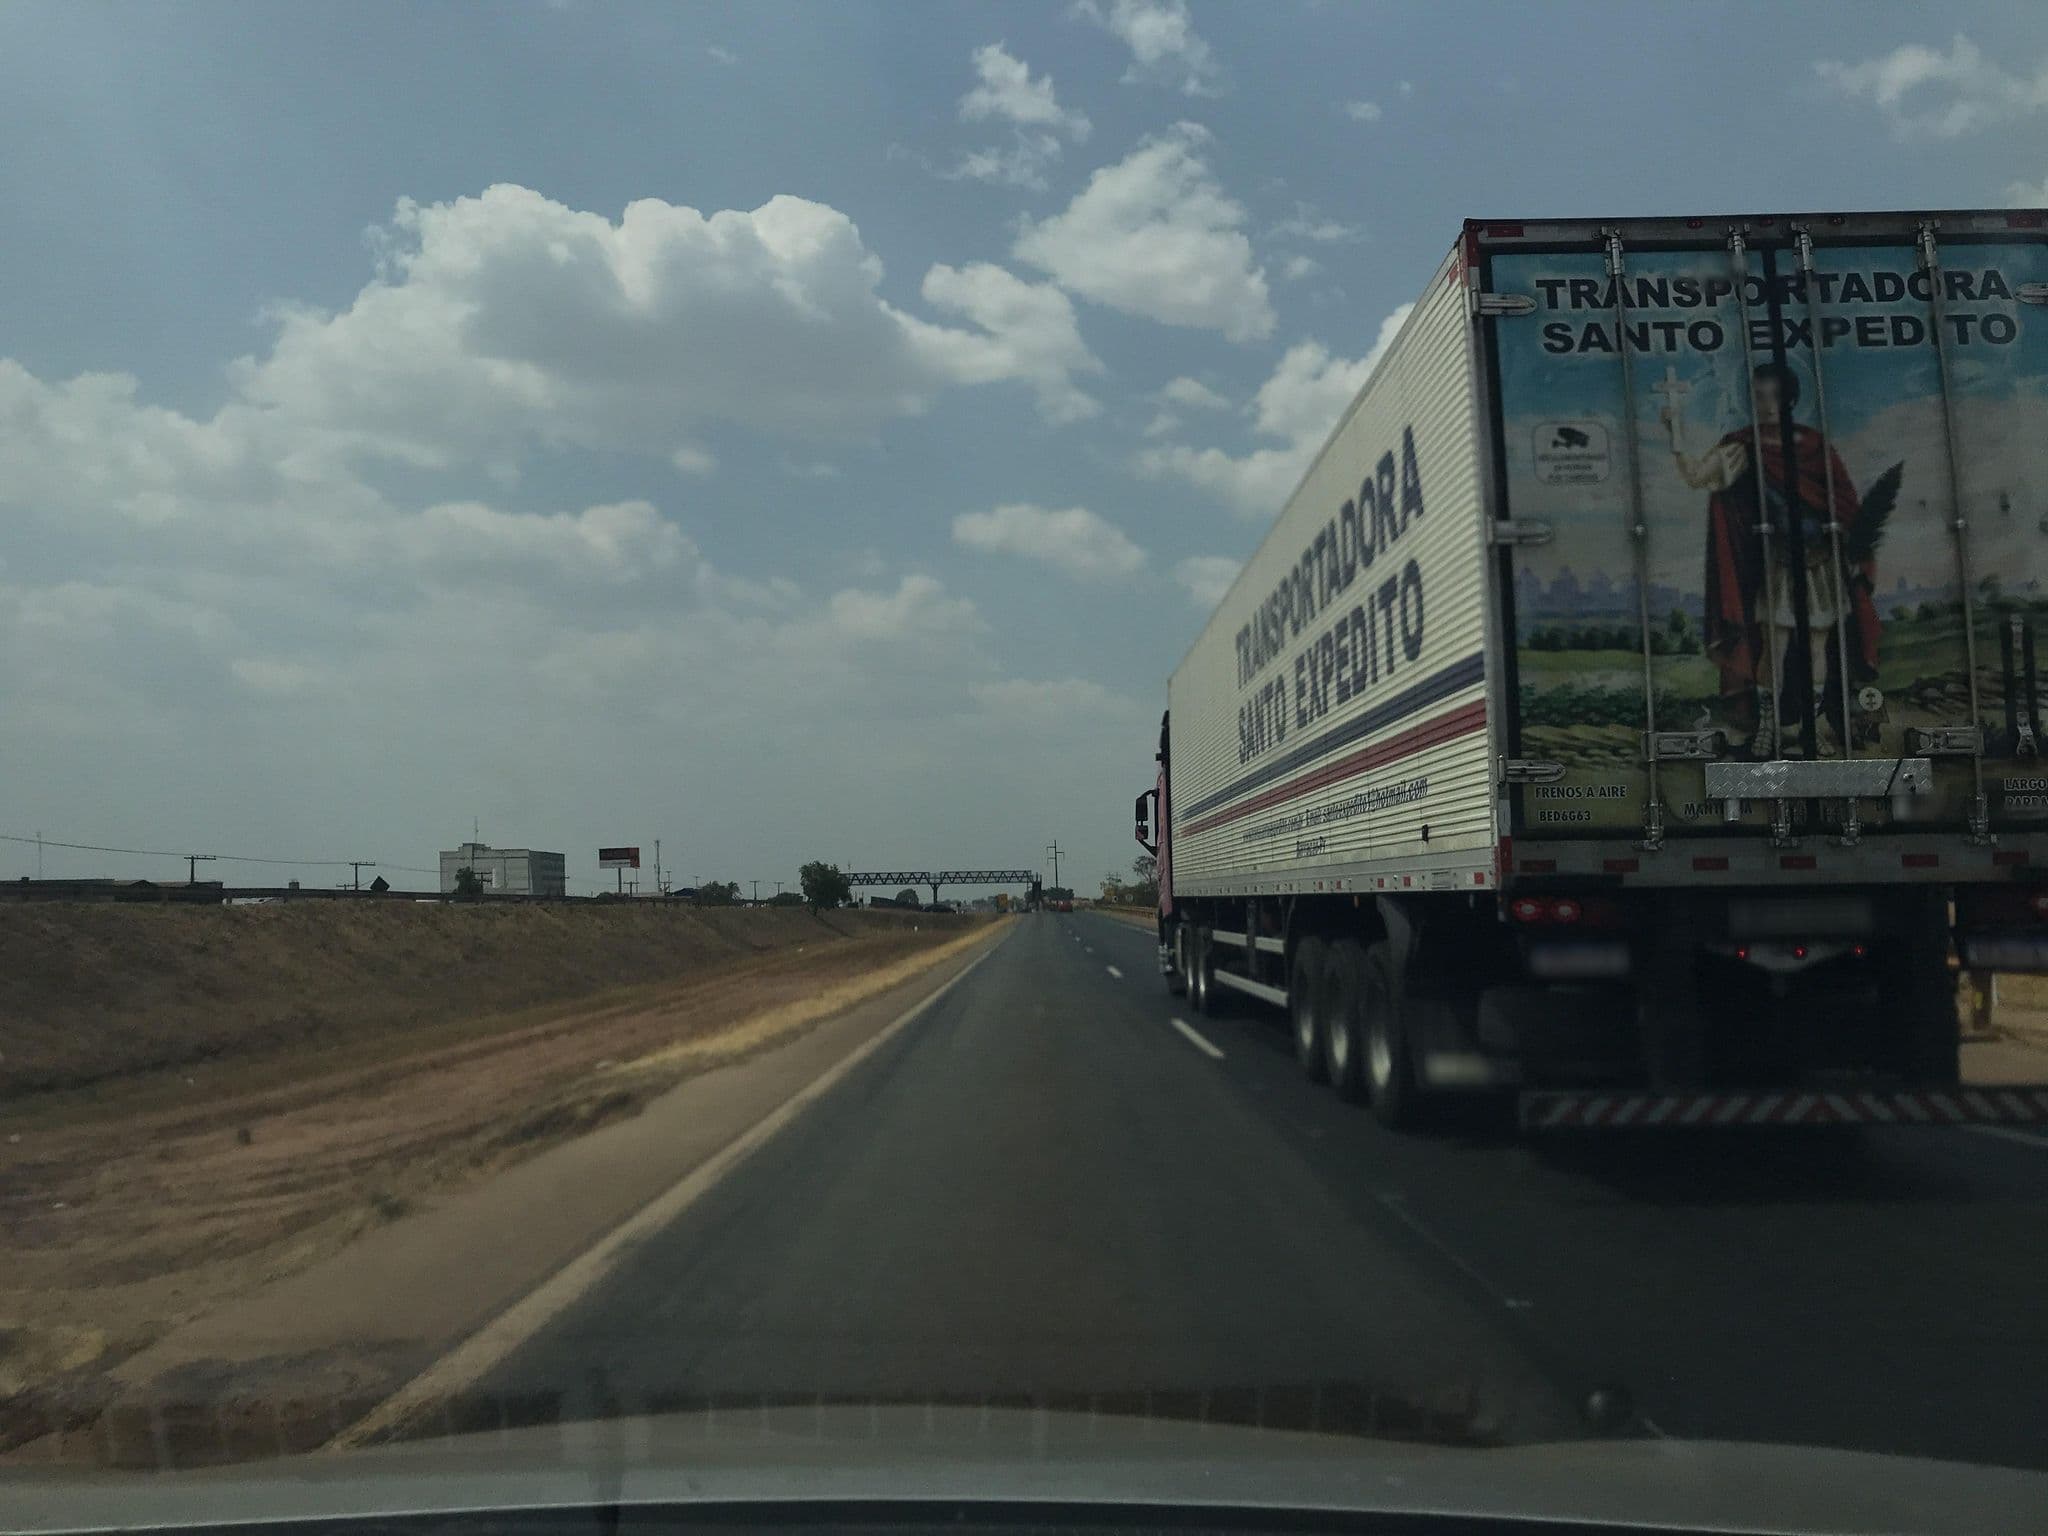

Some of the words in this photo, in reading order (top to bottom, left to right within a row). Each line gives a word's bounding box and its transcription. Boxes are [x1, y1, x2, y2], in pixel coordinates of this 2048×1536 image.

[1536, 270, 2013, 309] TRANSPORTADORA
[1543, 320, 1724, 353] SANTO
[1235, 424, 1424, 690] TRANSPORTADORA
[1238, 676, 1286, 764] SANTO
[1295, 558, 1424, 730] EXPEDITO
[1535, 786, 1582, 798] FRENOS
[1586, 786, 1594, 797] A
[1599, 785, 1626, 797] AIRE
[2005, 778, 2047, 790] LARGO
[1539, 810, 1591, 821] BED6G63
